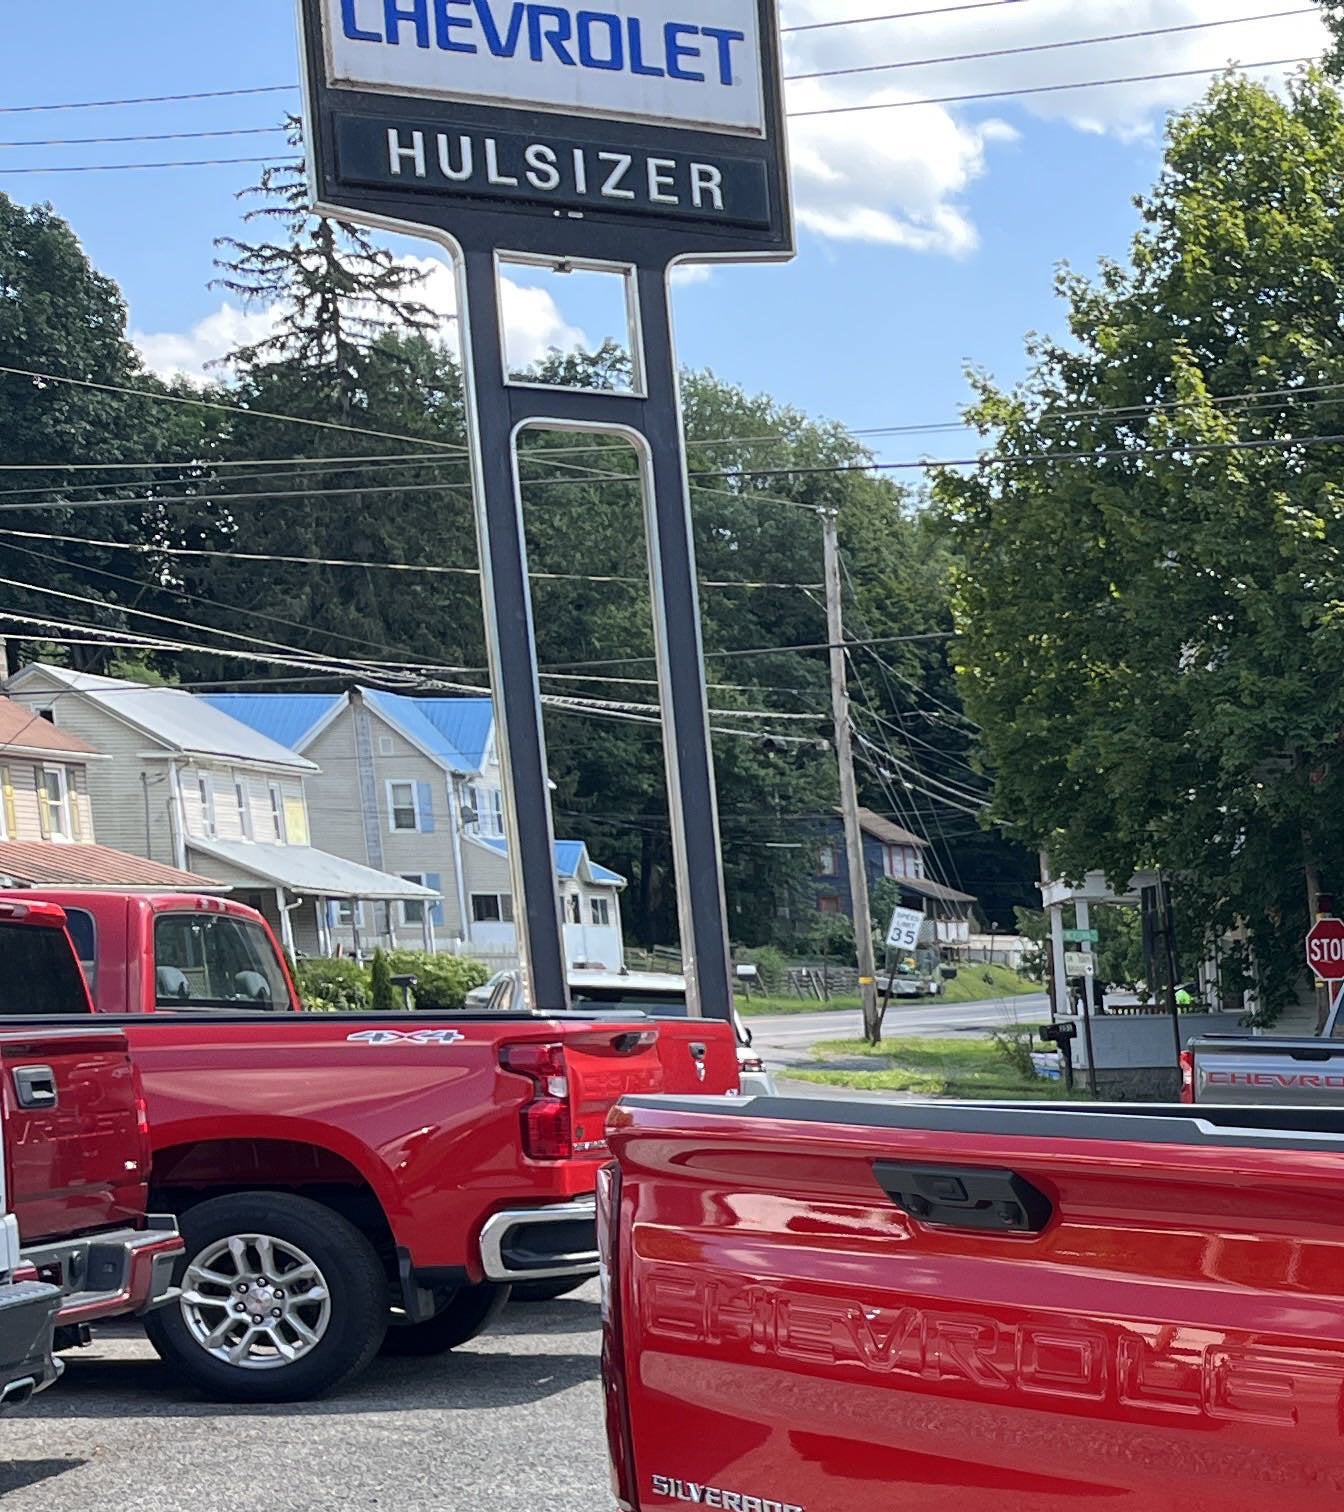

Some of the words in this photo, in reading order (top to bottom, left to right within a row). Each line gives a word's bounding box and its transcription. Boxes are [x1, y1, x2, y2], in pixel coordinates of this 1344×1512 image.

[341, 0, 744, 86] CHEVROLET
[387, 128, 724, 210] HULSIZER
[890, 927, 916, 945] 35
